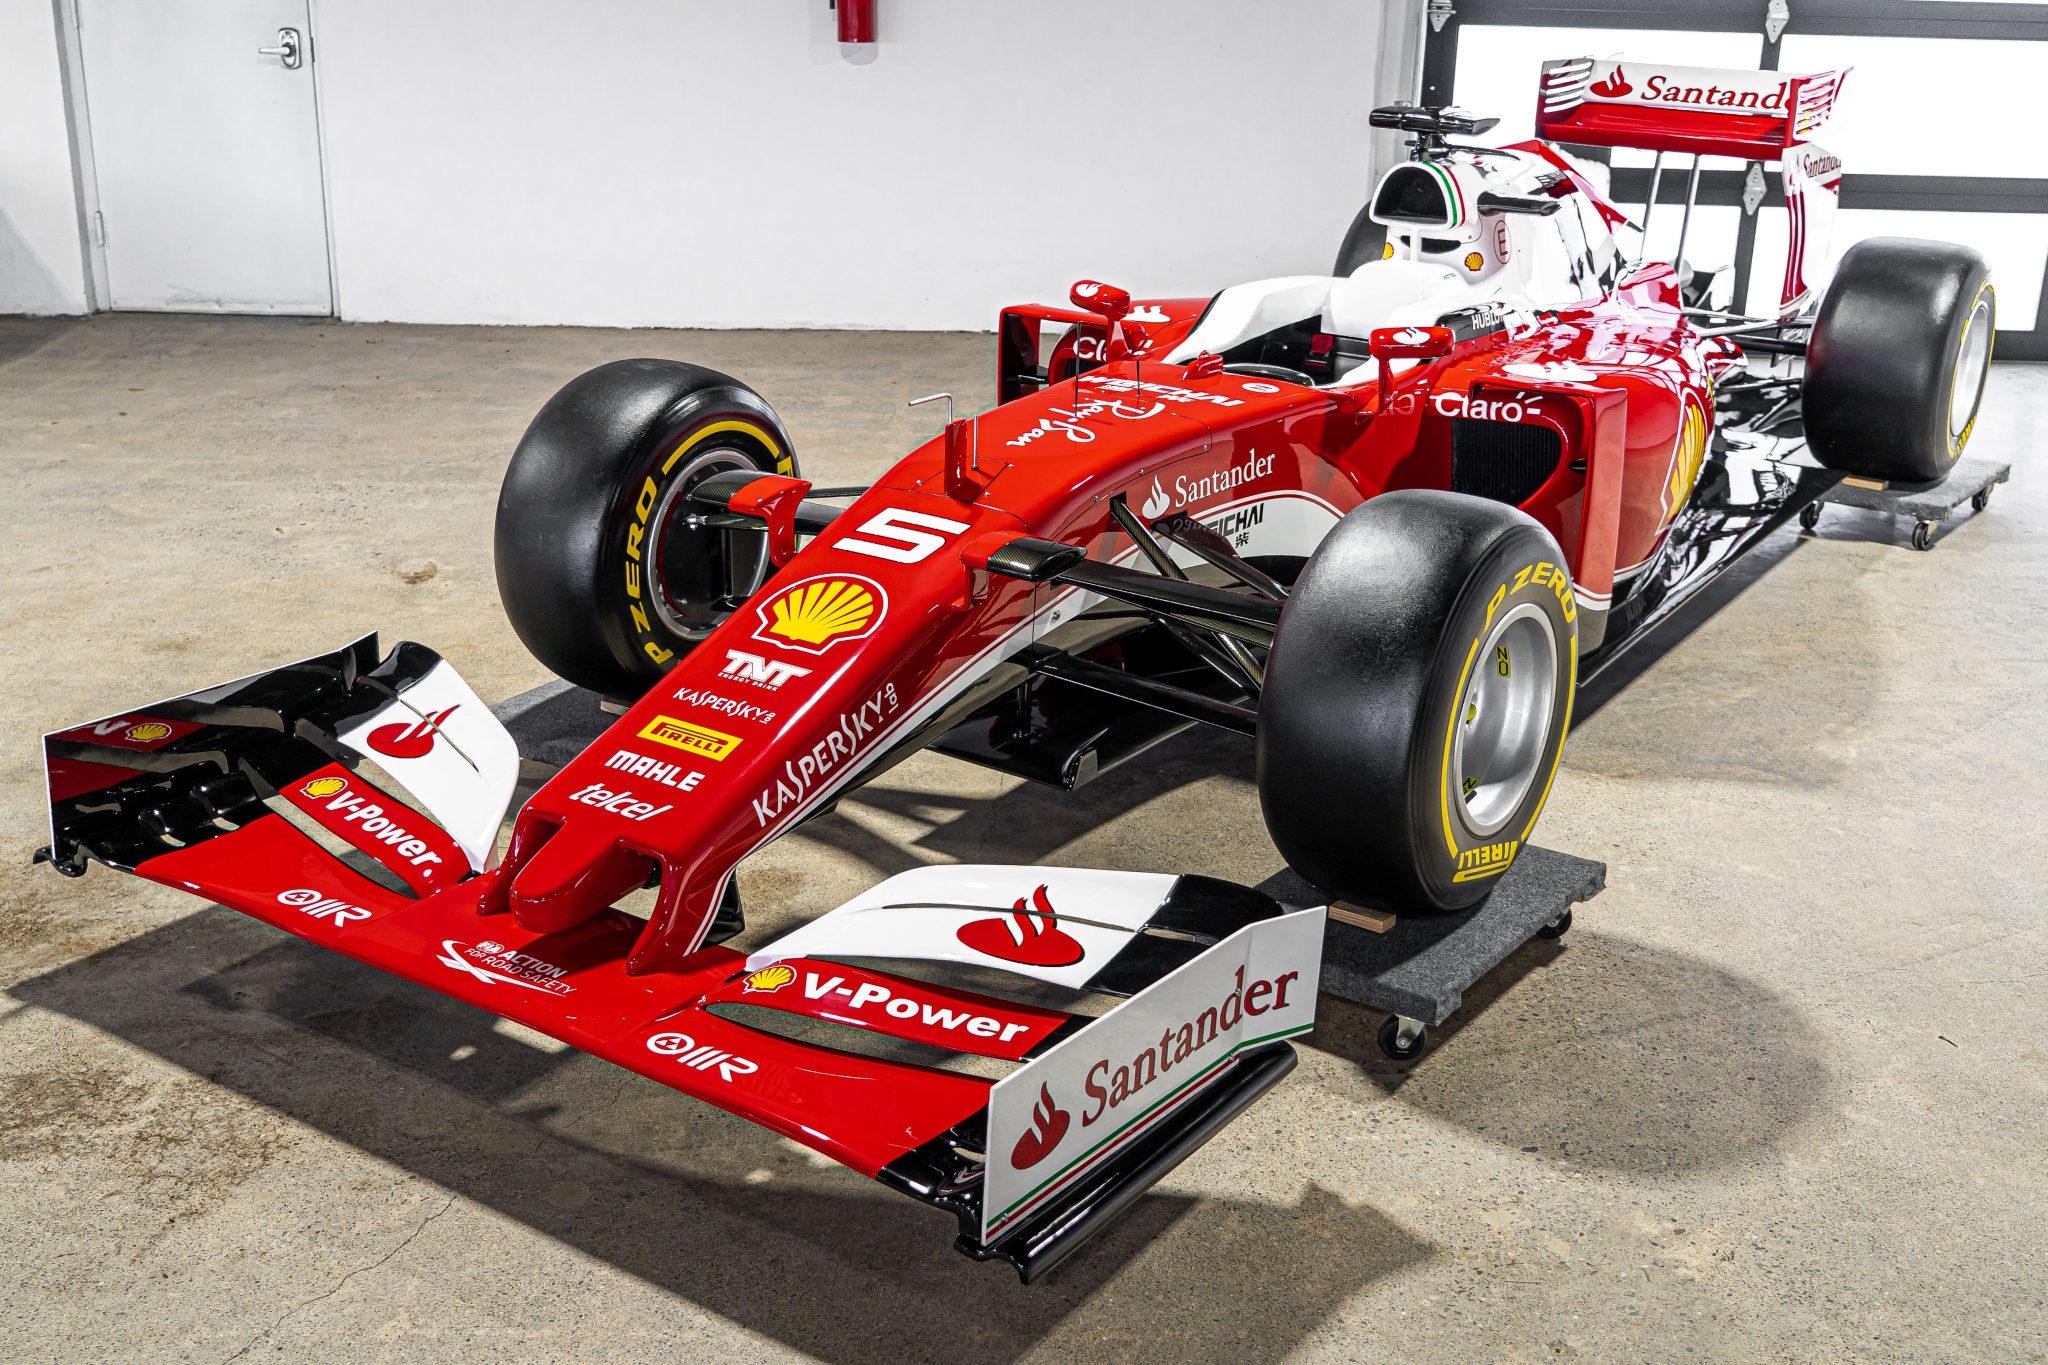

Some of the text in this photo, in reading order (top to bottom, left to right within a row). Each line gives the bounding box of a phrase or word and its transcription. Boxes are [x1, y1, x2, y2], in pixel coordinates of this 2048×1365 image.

[1430, 391, 1523, 423] Claro
[1175, 447, 1275, 508] Santander
[831, 507, 973, 564] 5
[626, 476, 674, 664] P ZERO
[1483, 583, 1506, 633] P
[1509, 561, 1576, 624] ZERO
[718, 672, 779, 692] ENERGY DRINK
[722, 649, 813, 687] TNT
[673, 688, 768, 720] KASPERSKY
[650, 721, 729, 754] PIRELLI
[752, 690, 883, 827] KASPERSKY
[604, 750, 706, 792] MAHLE
[568, 783, 675, 821] telcel
[1452, 840, 1518, 883] PIRELLI
[464, 948, 577, 994] FOR ROAD SAFETY
[498, 950, 568, 978] ACTION
[804, 972, 1029, 1042] V-Power
[1081, 964, 1298, 1128] Santander
